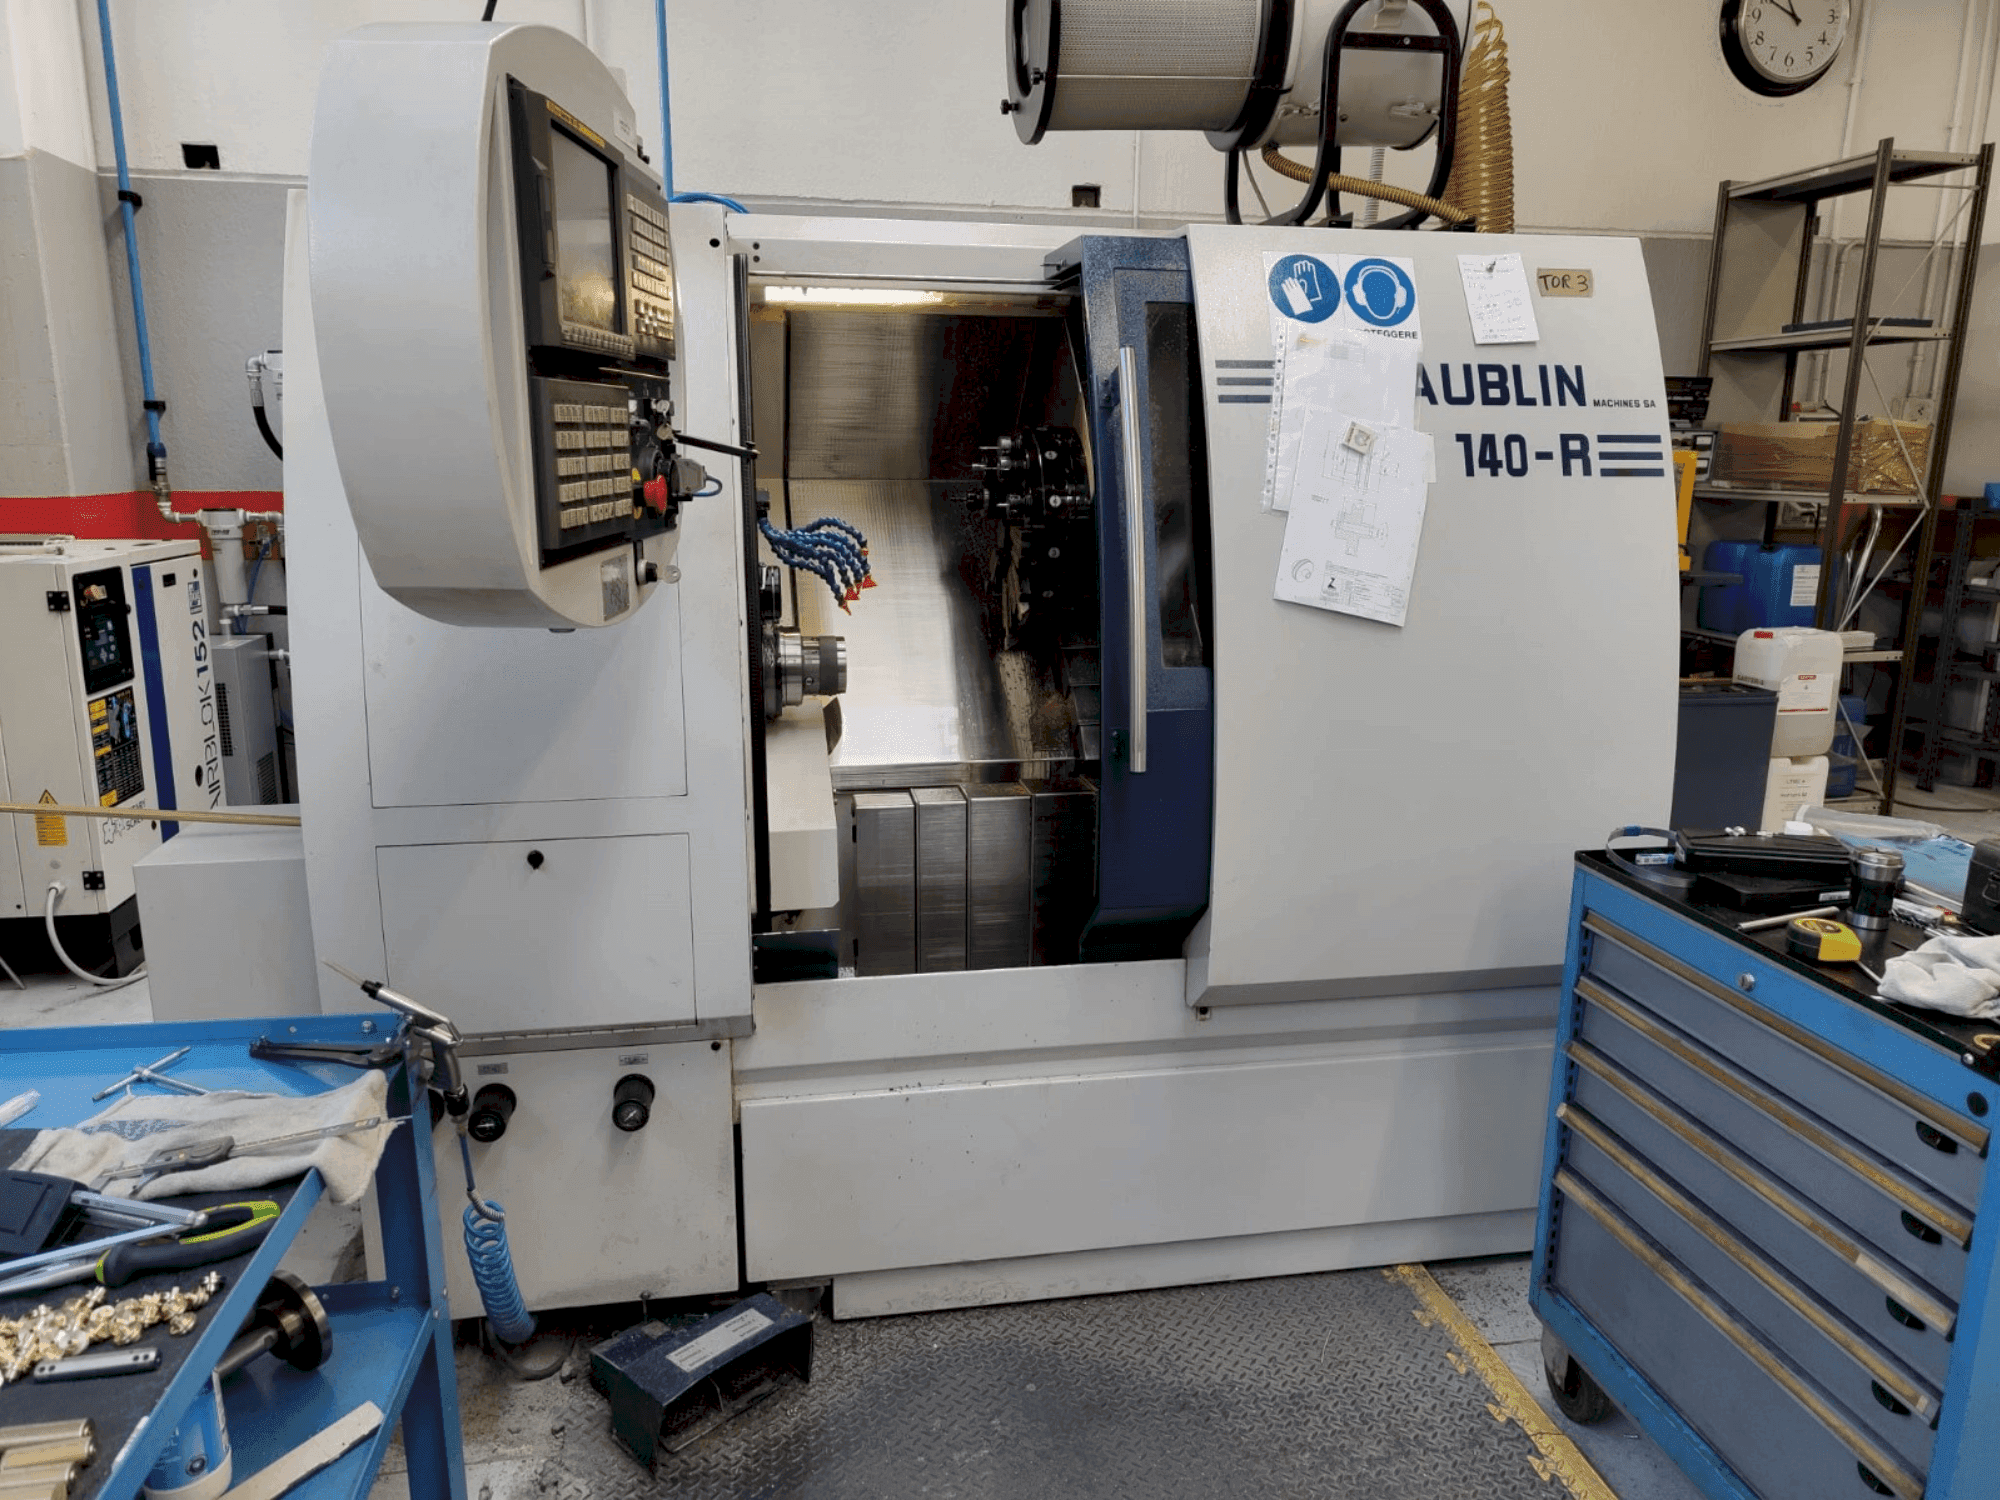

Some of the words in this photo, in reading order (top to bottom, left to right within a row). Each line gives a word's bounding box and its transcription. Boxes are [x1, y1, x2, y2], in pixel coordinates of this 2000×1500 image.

[1752, 8, 1761, 23] 9
[1827, 9, 1835, 24] 3
[1755, 30, 1764, 45] 8
[1818, 30, 1827, 45] 4
[1770, 46, 1777, 60] 7
[1784, 52, 1794, 67] 6
[1805, 46, 1814, 62] 5
[1538, 274, 1571, 291] TOR
[1577, 274, 1589, 292] 3
[1593, 399, 1641, 408] MACHINES
[1643, 399, 1656, 408] SA
[1455, 433, 1592, 477] 140-R
[192, 619, 208, 678] 152
